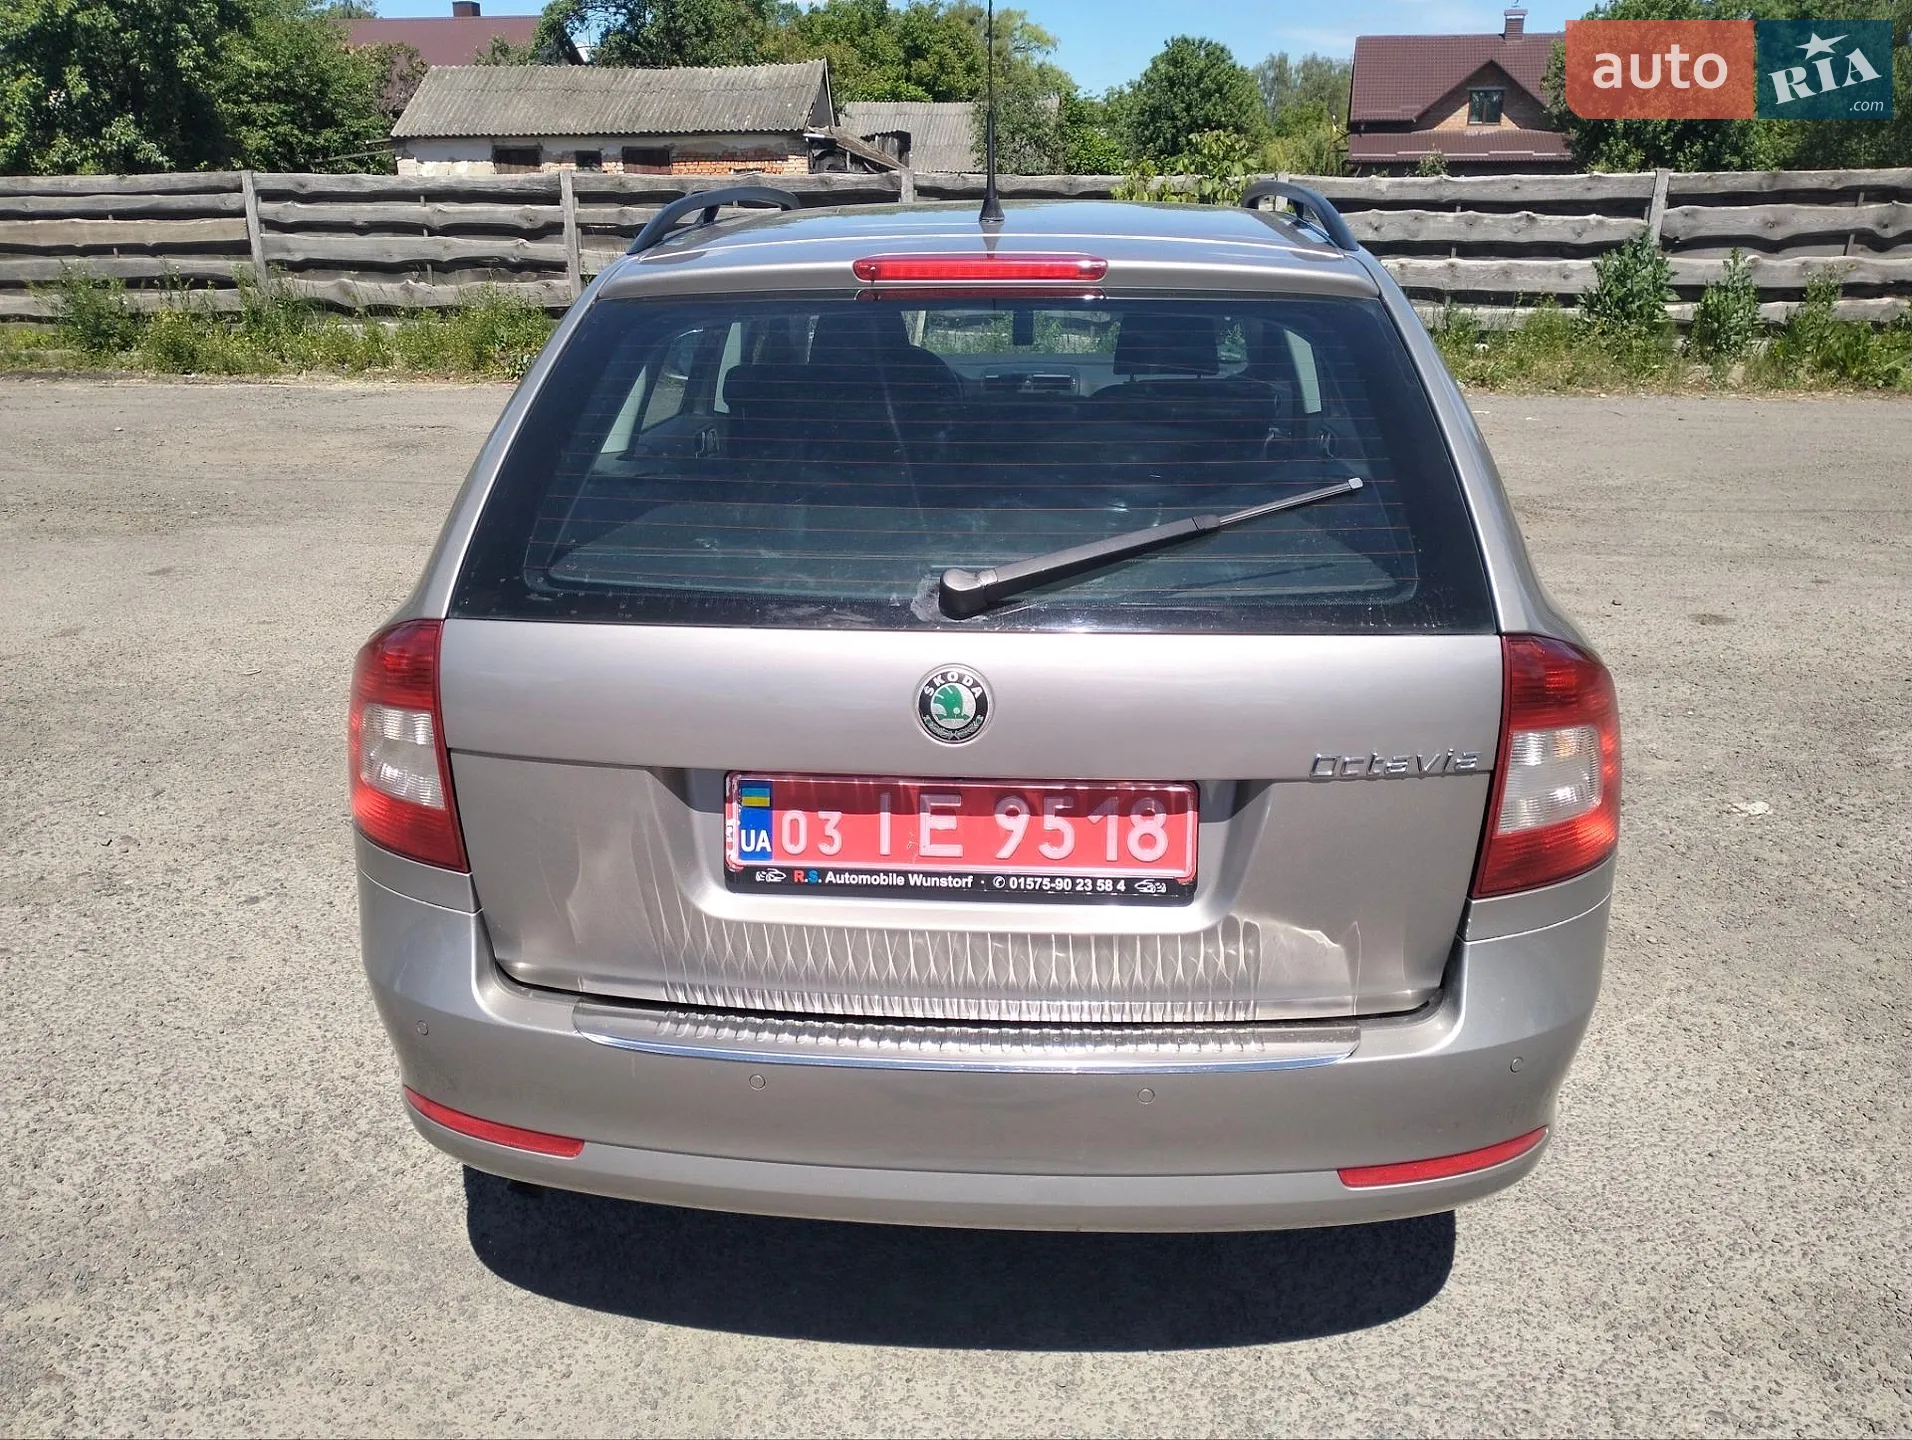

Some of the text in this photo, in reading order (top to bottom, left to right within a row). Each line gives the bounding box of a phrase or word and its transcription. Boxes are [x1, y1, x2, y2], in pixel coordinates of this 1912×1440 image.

[781, 792, 1170, 862] 03 IE 9518
[740, 829, 772, 853] UA
[793, 869, 1126, 892] R.S. Automobile Wunstorf 01575-90 23 58 4
